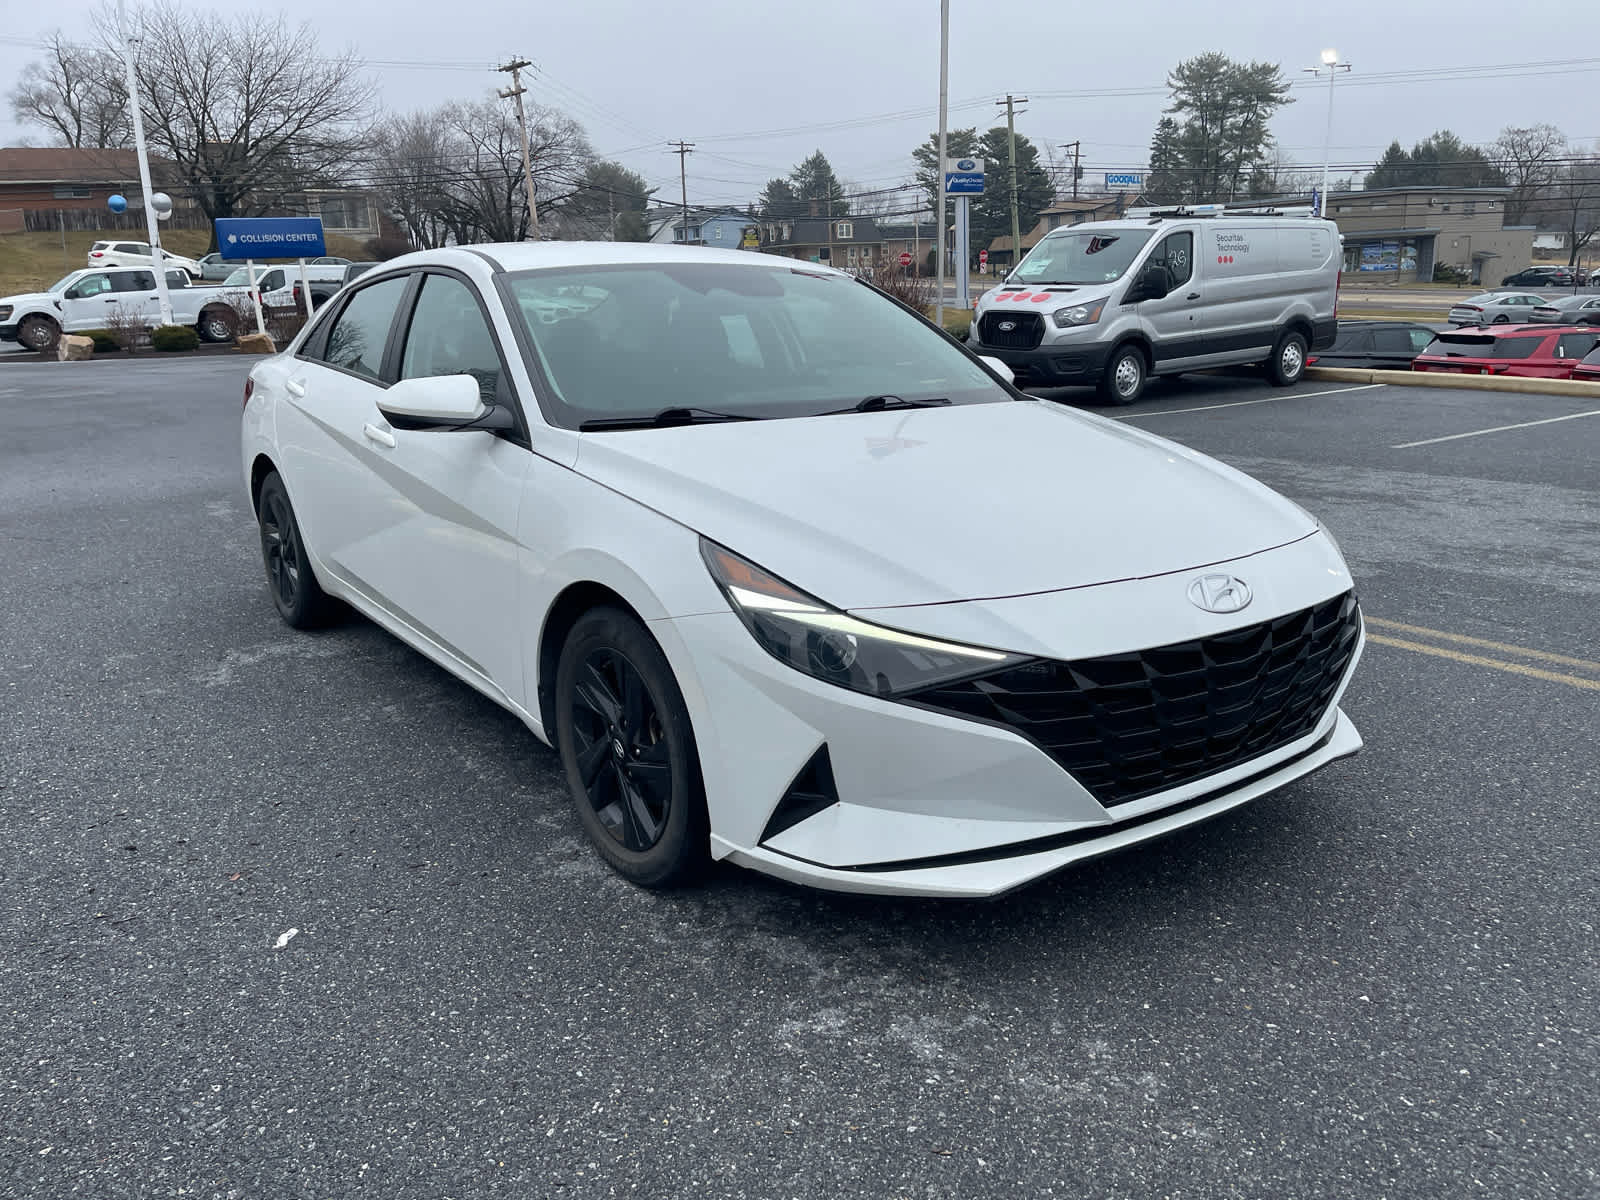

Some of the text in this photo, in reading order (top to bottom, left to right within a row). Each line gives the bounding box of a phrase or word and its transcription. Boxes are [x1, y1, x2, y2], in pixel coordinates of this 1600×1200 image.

[1108, 175, 1140, 184] GOODALL
[240, 233, 318, 243] COLLISION CENTER
[1216, 233, 1243, 241] Securitas
[1217, 244, 1249, 253] Technology
